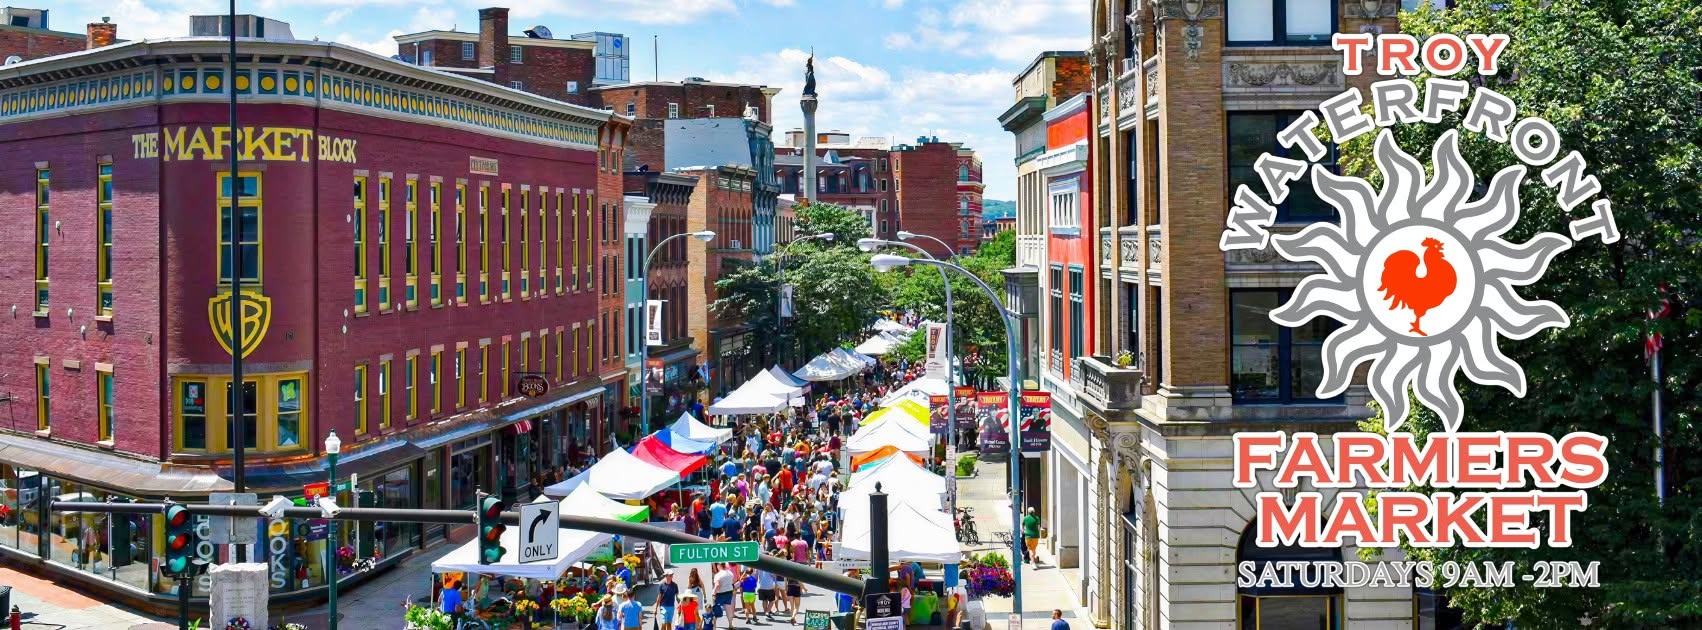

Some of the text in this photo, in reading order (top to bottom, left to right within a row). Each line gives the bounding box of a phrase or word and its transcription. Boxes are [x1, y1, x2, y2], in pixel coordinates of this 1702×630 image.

[132, 126, 357, 164] THE MARKET BLOCK
[268, 519, 287, 589] OOKS
[524, 544, 553, 558] ONLY
[679, 546, 749, 560] FULTON ST
